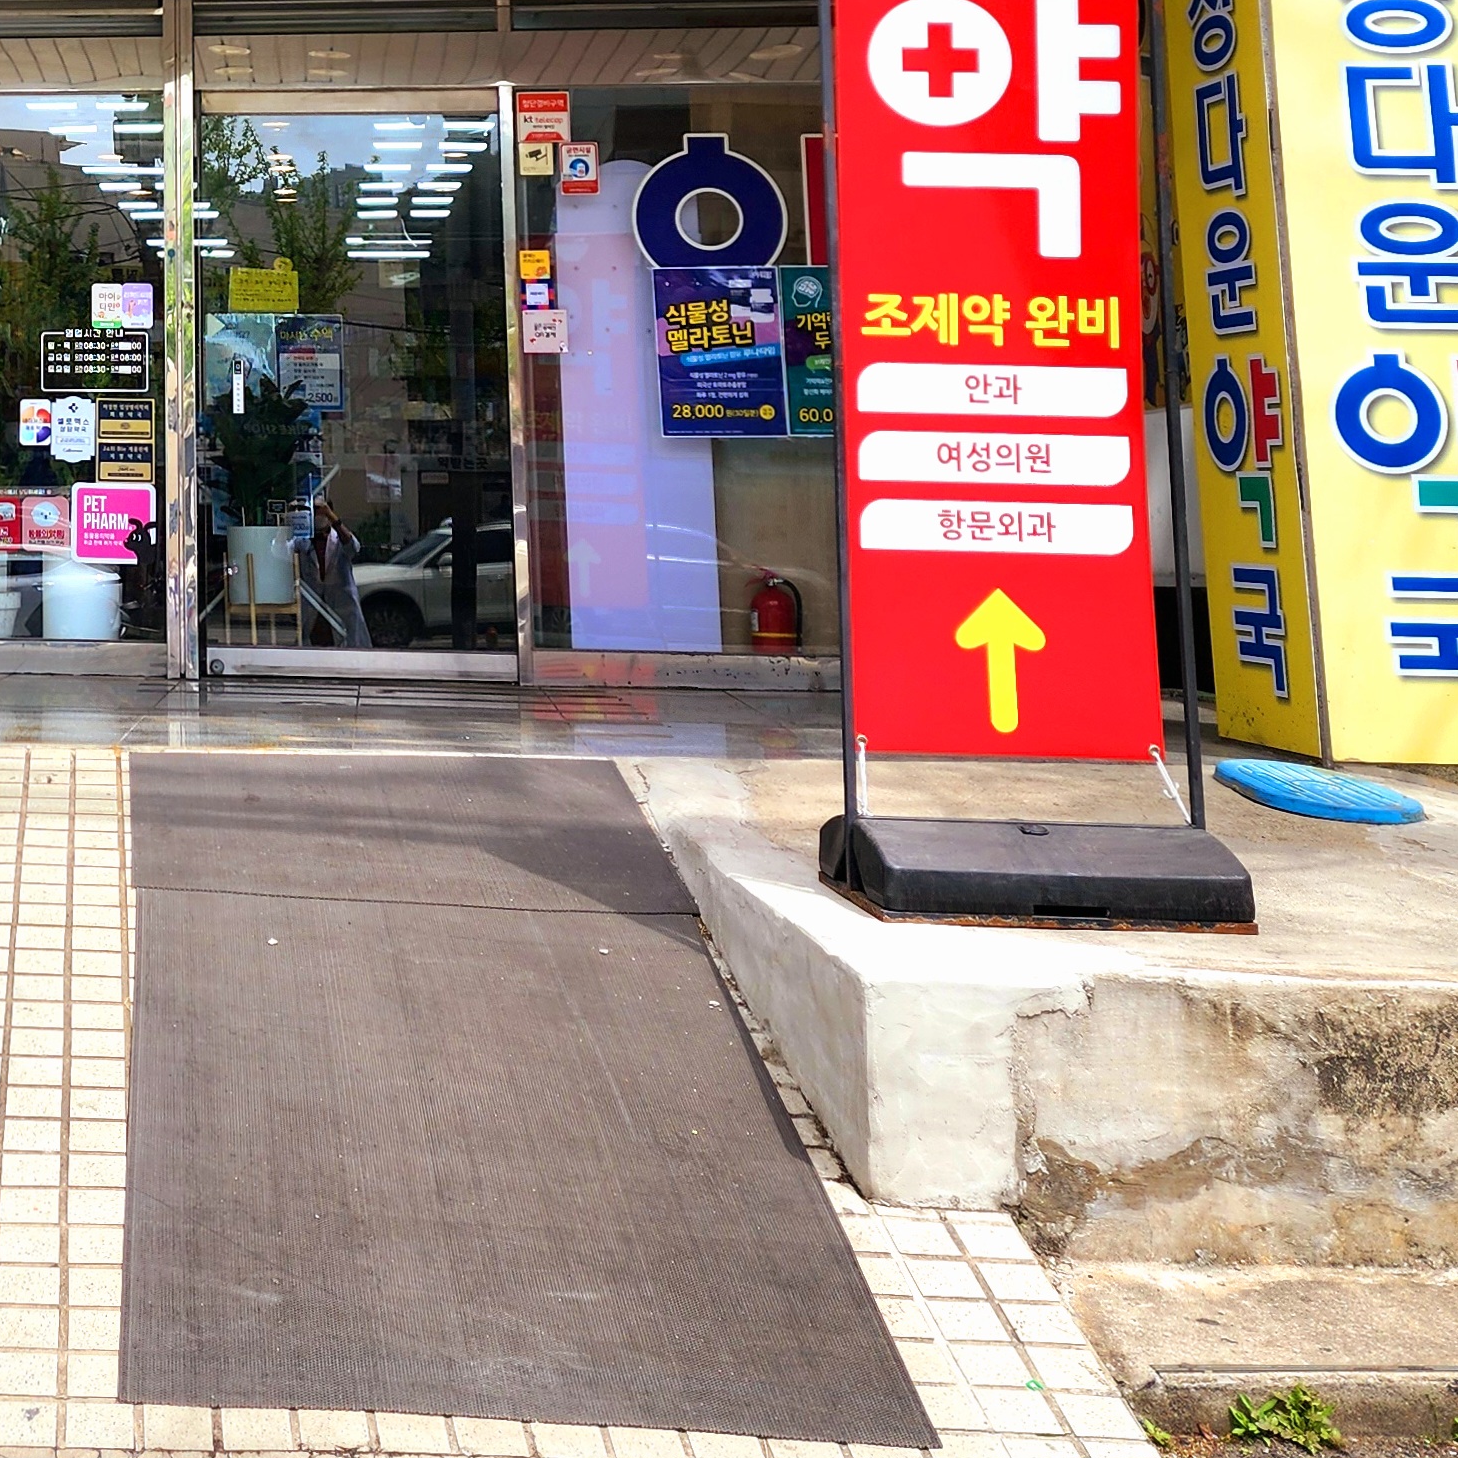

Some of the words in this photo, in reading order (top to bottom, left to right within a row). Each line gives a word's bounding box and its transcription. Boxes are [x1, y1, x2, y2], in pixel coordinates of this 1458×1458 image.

[523, 115, 533, 124] kt
[665, 299, 730, 326] 식물성
[861, 293, 1011, 348] 조제약
[1024, 293, 1121, 350] 완비
[666, 321, 753, 352] 멜라토닌
[964, 372, 1023, 406] 안과
[672, 403, 724, 420] 28,000
[935, 442, 1054, 476] 여성의원
[83, 495, 108, 513] PET
[937, 508, 1057, 544] 항문외과
